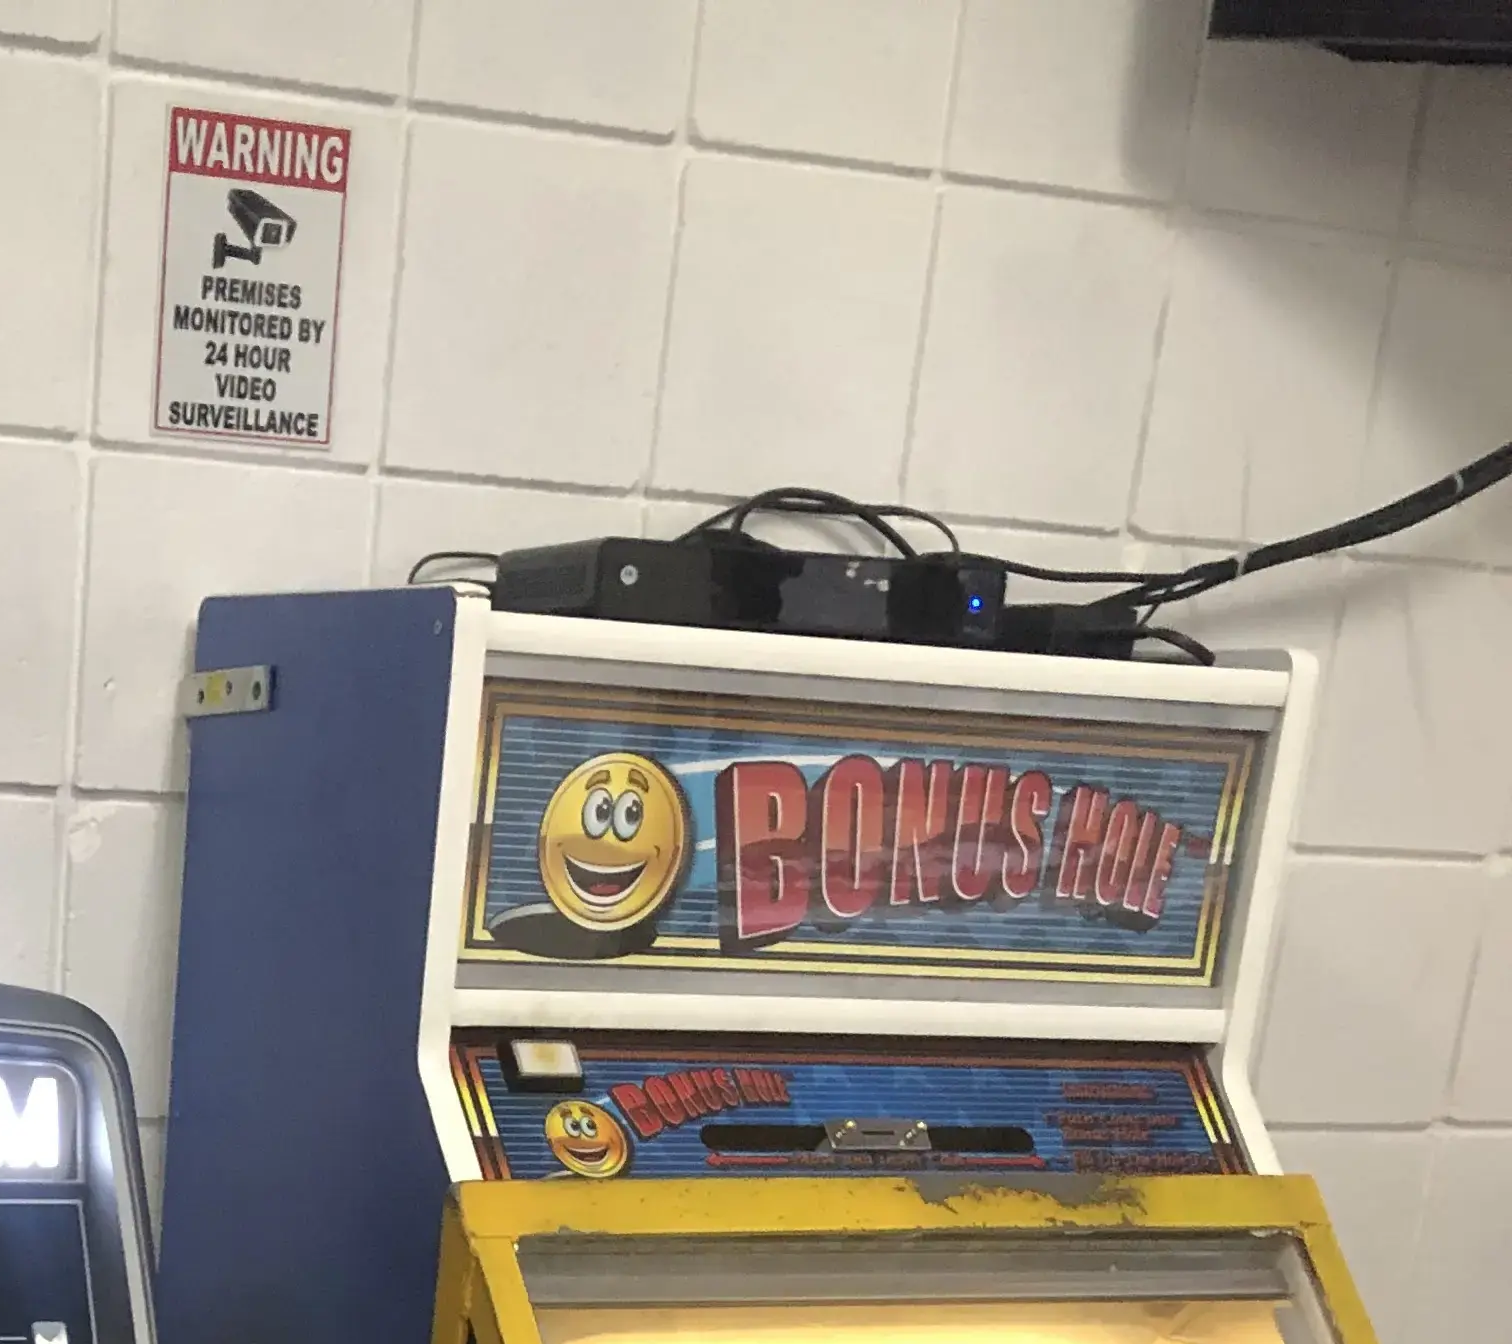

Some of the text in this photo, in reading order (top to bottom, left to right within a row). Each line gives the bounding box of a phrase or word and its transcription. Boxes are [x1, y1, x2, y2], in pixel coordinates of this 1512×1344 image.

[175, 116, 344, 184] WARNING
[201, 275, 302, 310] PREMISES
[173, 304, 326, 344] MONITORED BY
[204, 340, 291, 373] 24 HOUR
[215, 373, 276, 402] VIDEO
[168, 400, 319, 437] SURVEILLANCE
[716, 754, 1181, 945] BONUS HOLE
[610, 1068, 740, 1138] BONUS
